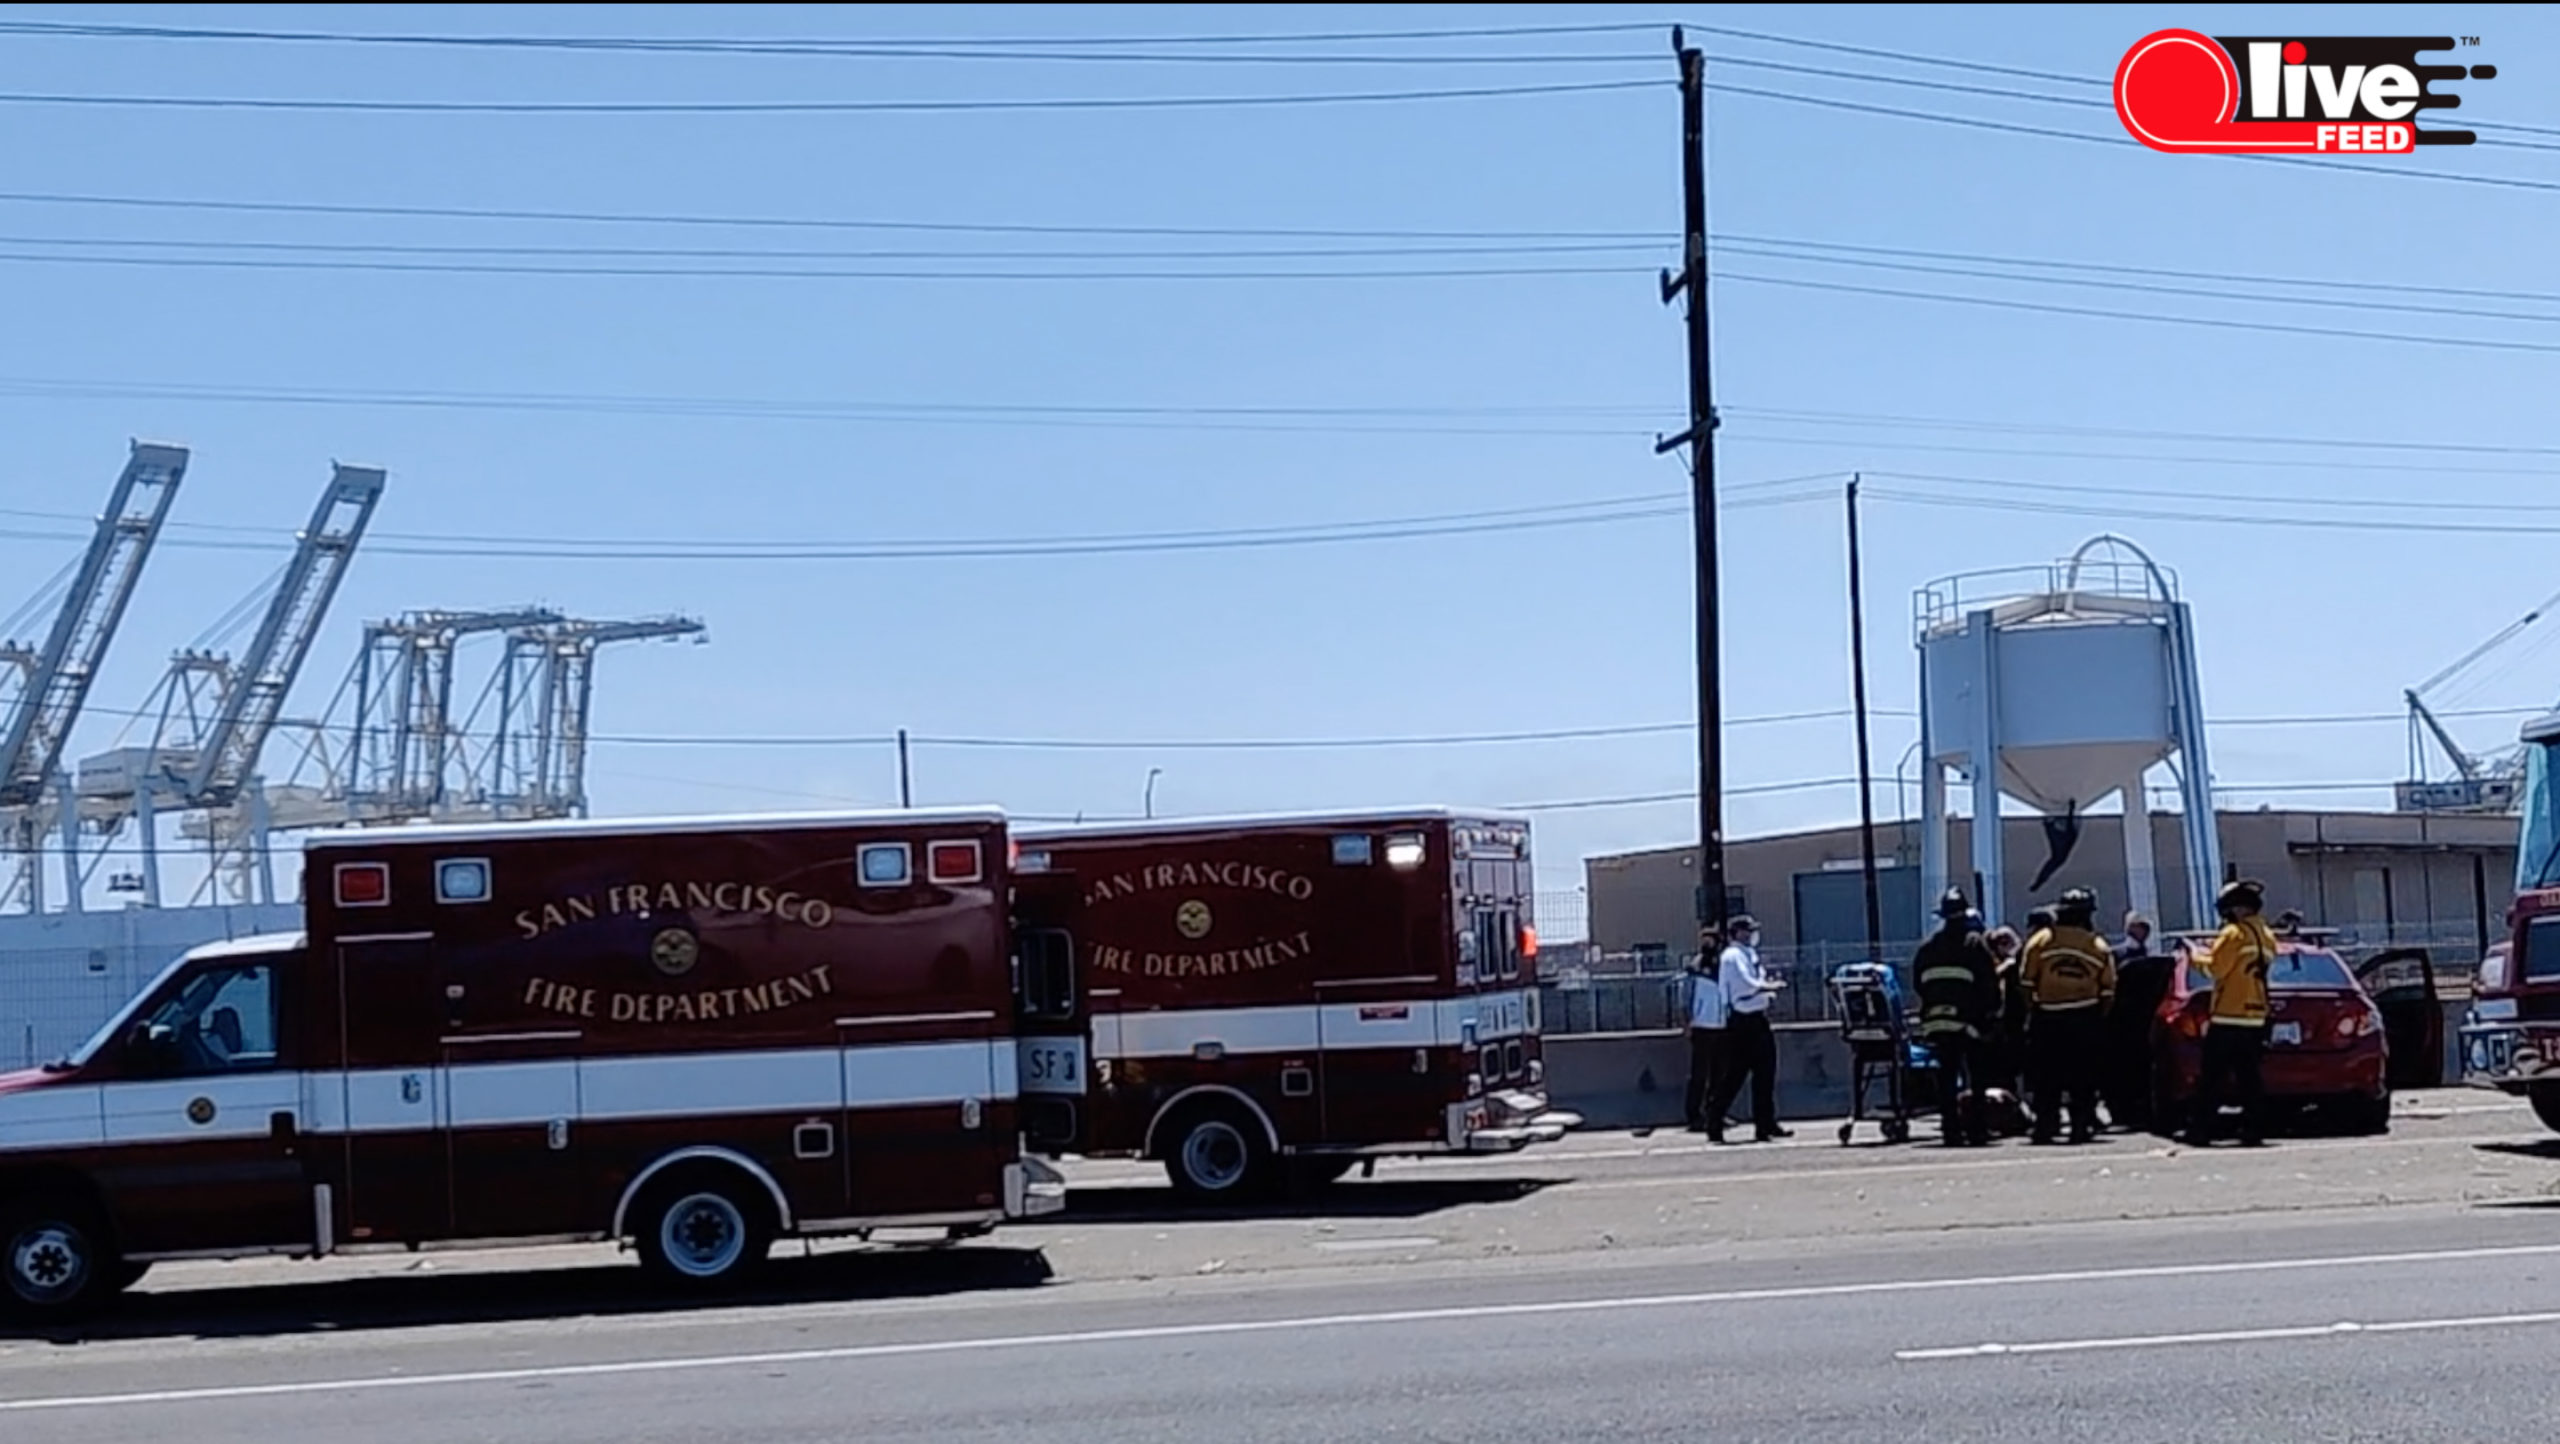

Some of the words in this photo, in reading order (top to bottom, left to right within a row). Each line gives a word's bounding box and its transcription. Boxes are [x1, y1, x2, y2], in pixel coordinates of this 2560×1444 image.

[1085, 874, 1134, 907] AN
[1143, 861, 1313, 899] FRANCISCO
[514, 893, 596, 940] SAN
[608, 881, 832, 928] FRANCISCO
[1087, 941, 1132, 974] IRE
[1144, 931, 1312, 977] DEPARTMENT
[523, 977, 597, 1017] FIRE
[610, 964, 831, 1022] DEPARTMENT
